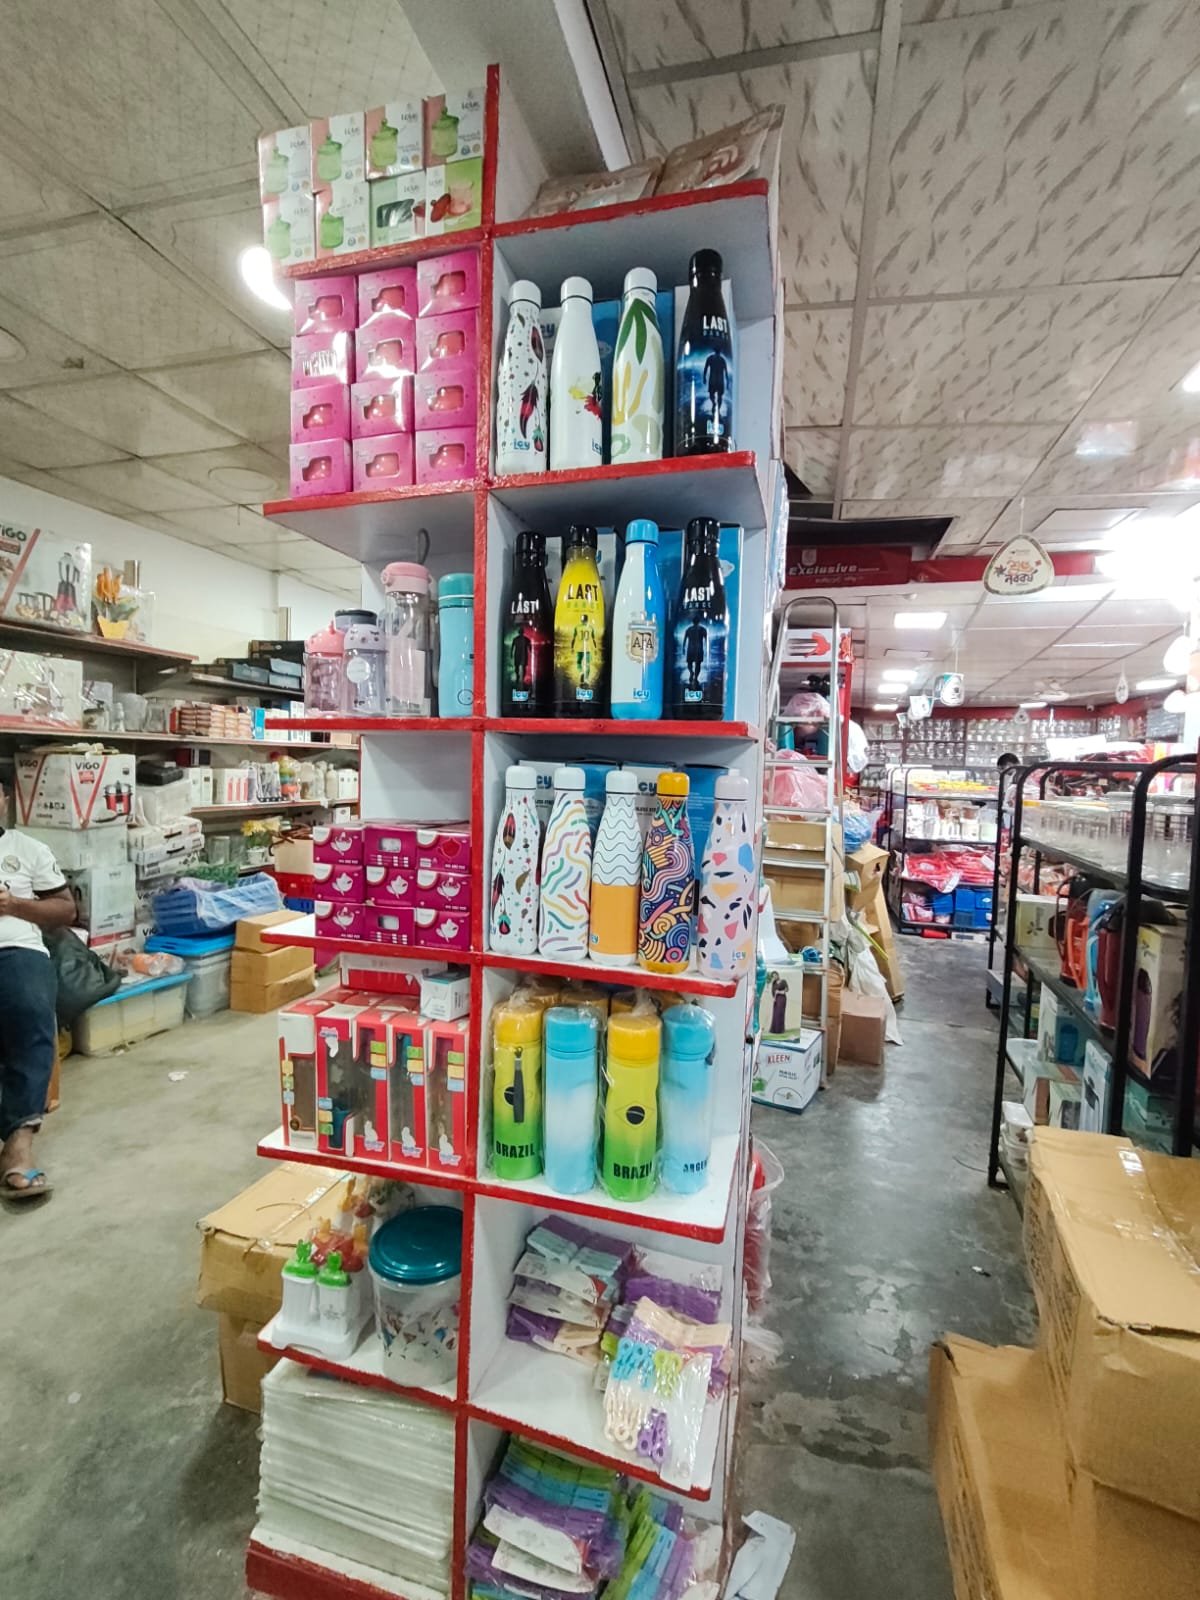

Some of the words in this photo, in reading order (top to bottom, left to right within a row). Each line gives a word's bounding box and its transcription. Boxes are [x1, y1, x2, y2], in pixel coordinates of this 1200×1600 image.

[567, 584, 598, 601] LAST
[684, 587, 711, 602] LAST
[511, 600, 536, 614] LAST
[632, 632, 654, 650] AFA
[496, 1140, 535, 1158] BRAZIL
